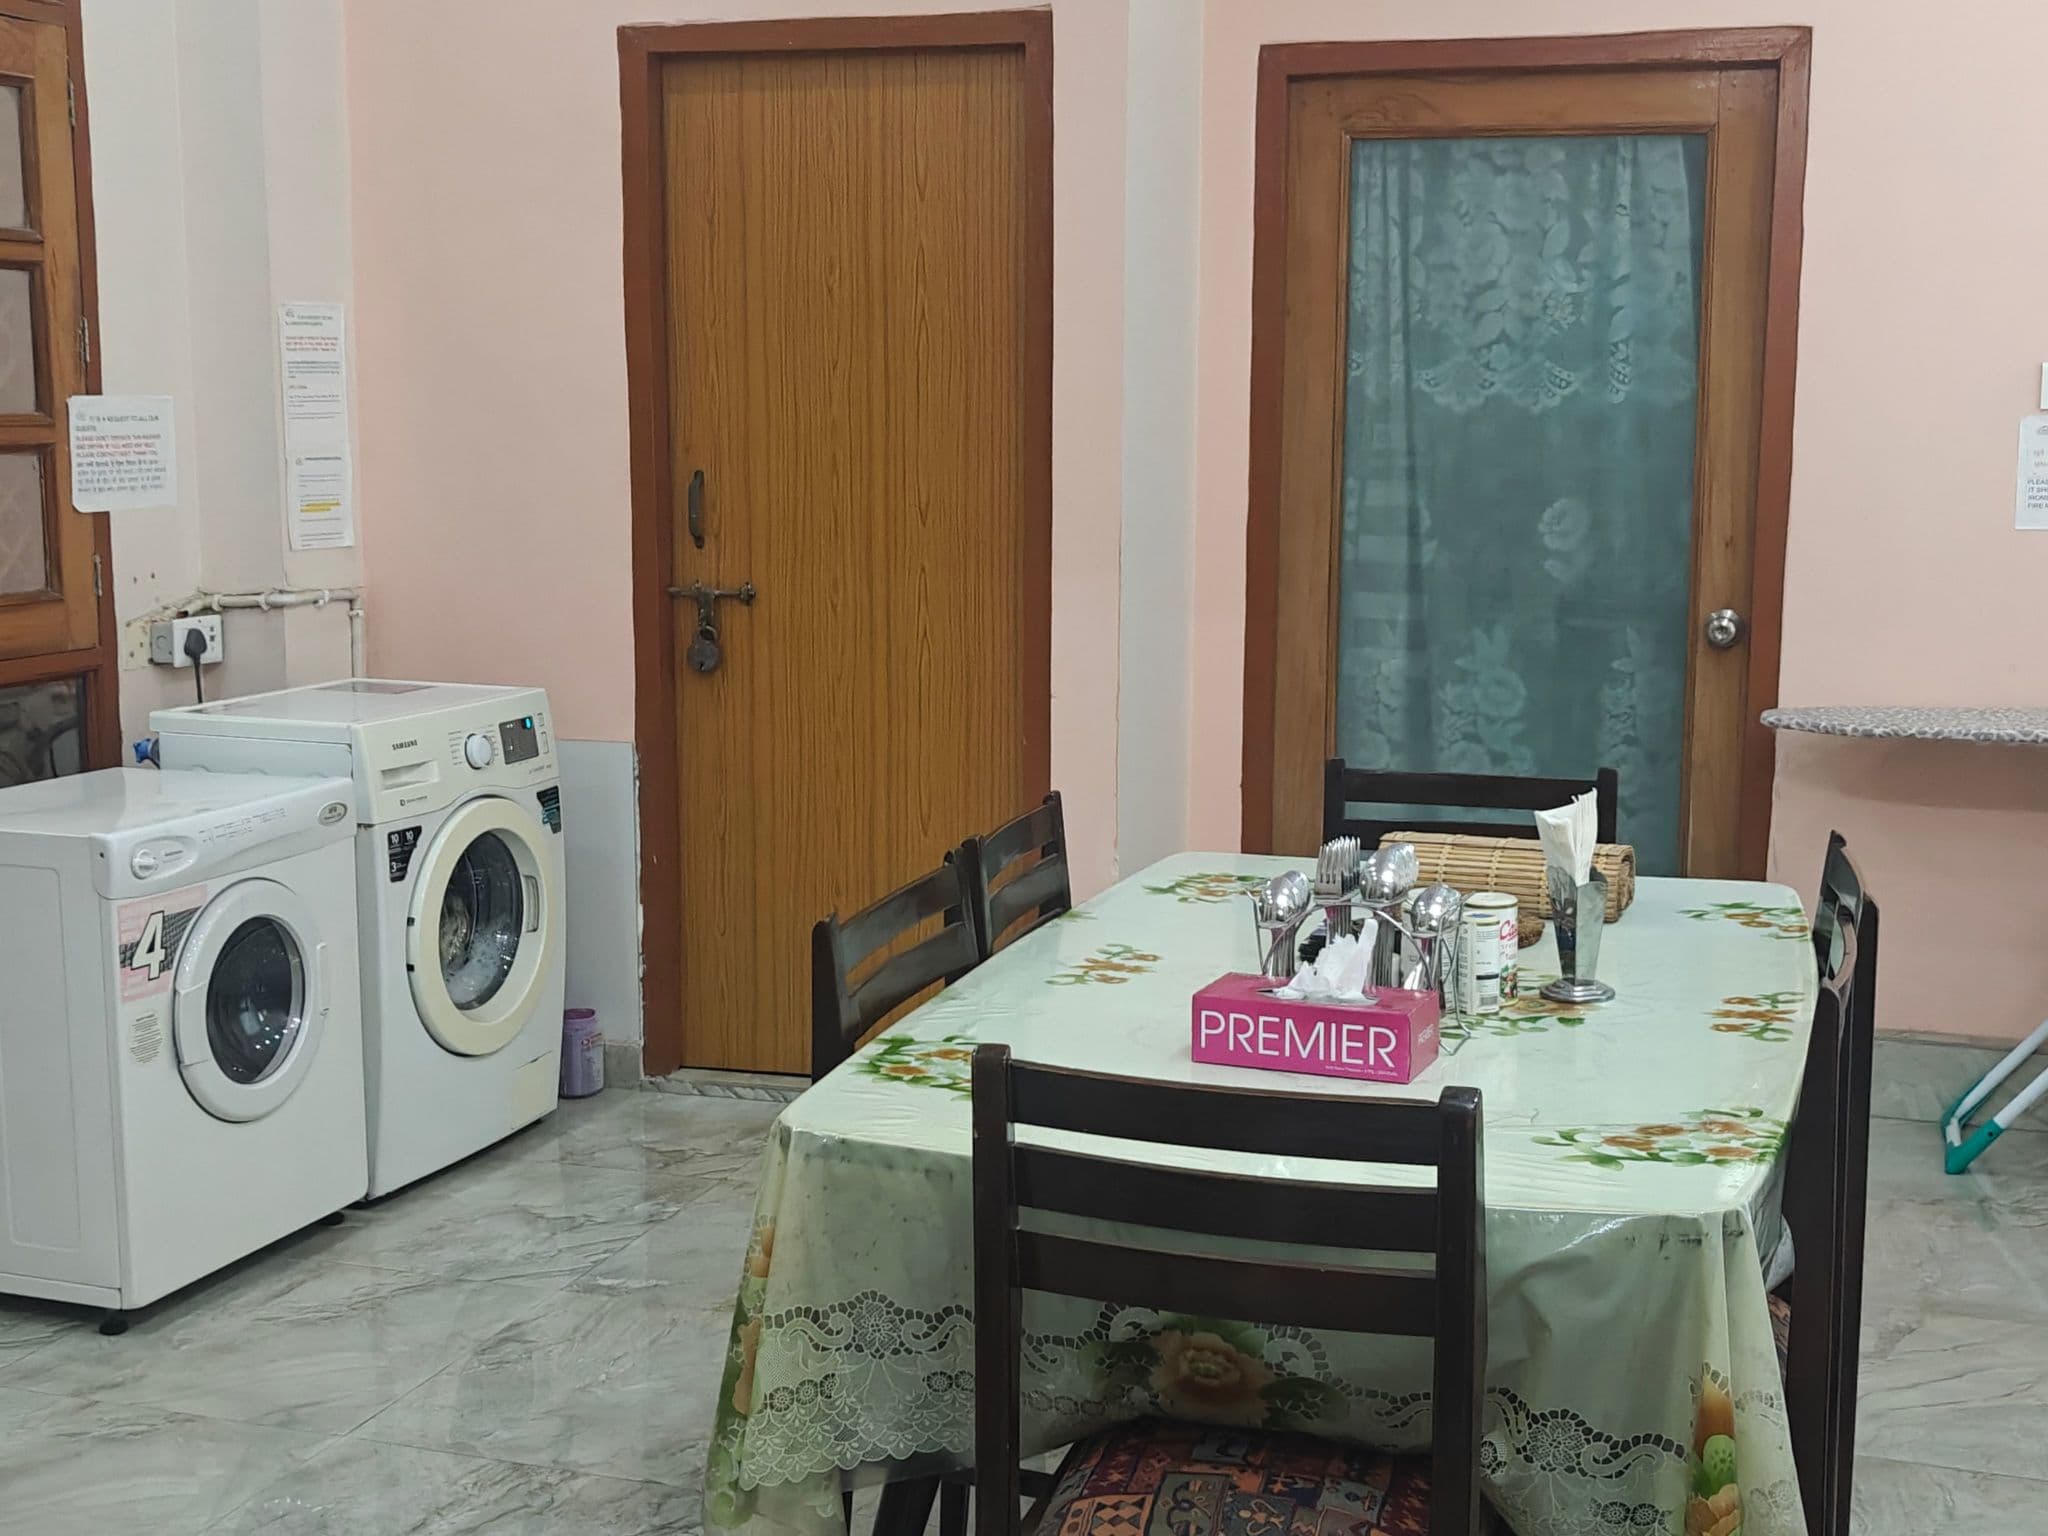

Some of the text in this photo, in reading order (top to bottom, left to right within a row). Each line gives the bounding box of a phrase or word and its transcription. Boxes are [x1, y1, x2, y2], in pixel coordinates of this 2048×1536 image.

[392, 739, 418, 750] SAMSUNG
[391, 830, 414, 845] 10 10
[131, 910, 167, 982] 4
[1200, 1009, 1397, 1068] PREMIER
